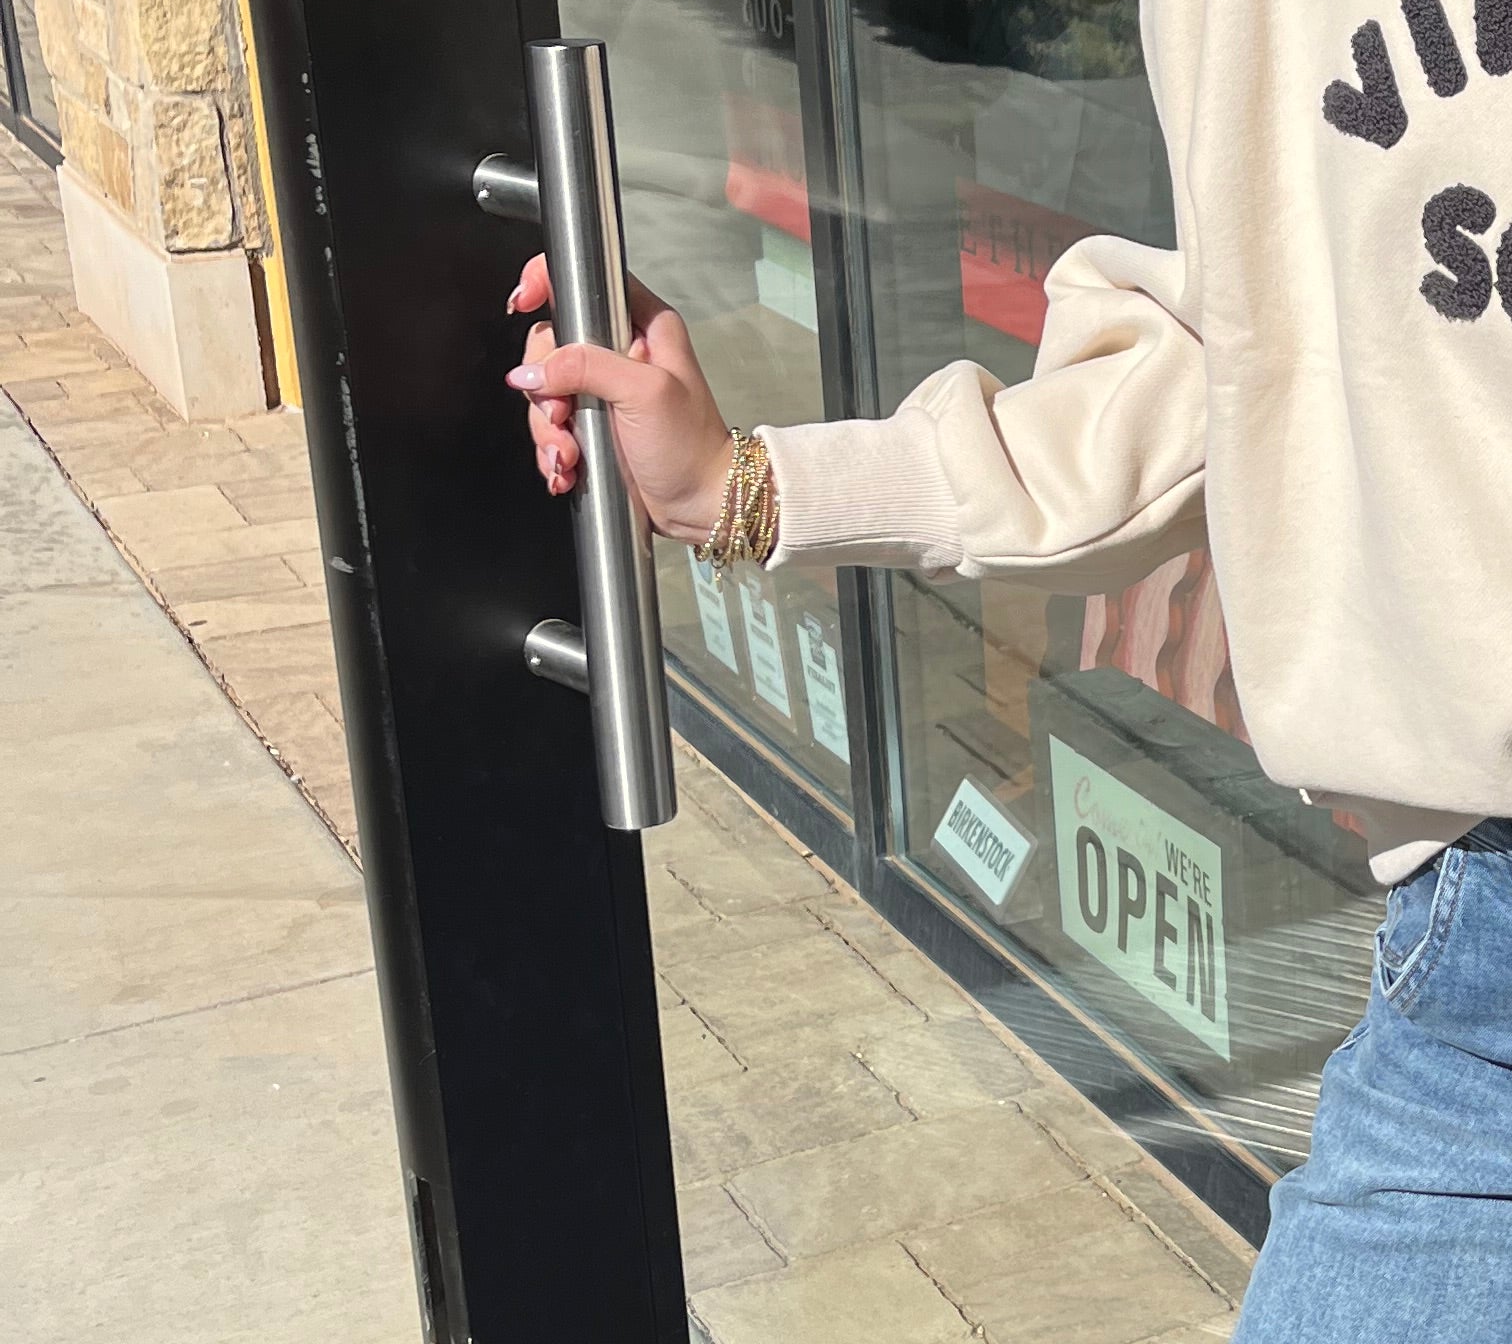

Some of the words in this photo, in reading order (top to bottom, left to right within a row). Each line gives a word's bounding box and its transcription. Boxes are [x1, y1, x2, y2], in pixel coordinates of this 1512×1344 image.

[947, 799, 1016, 883] BIRKENSTOCK
[1165, 839, 1212, 907] WE'RE
[1076, 825, 1216, 1023] OPEN
